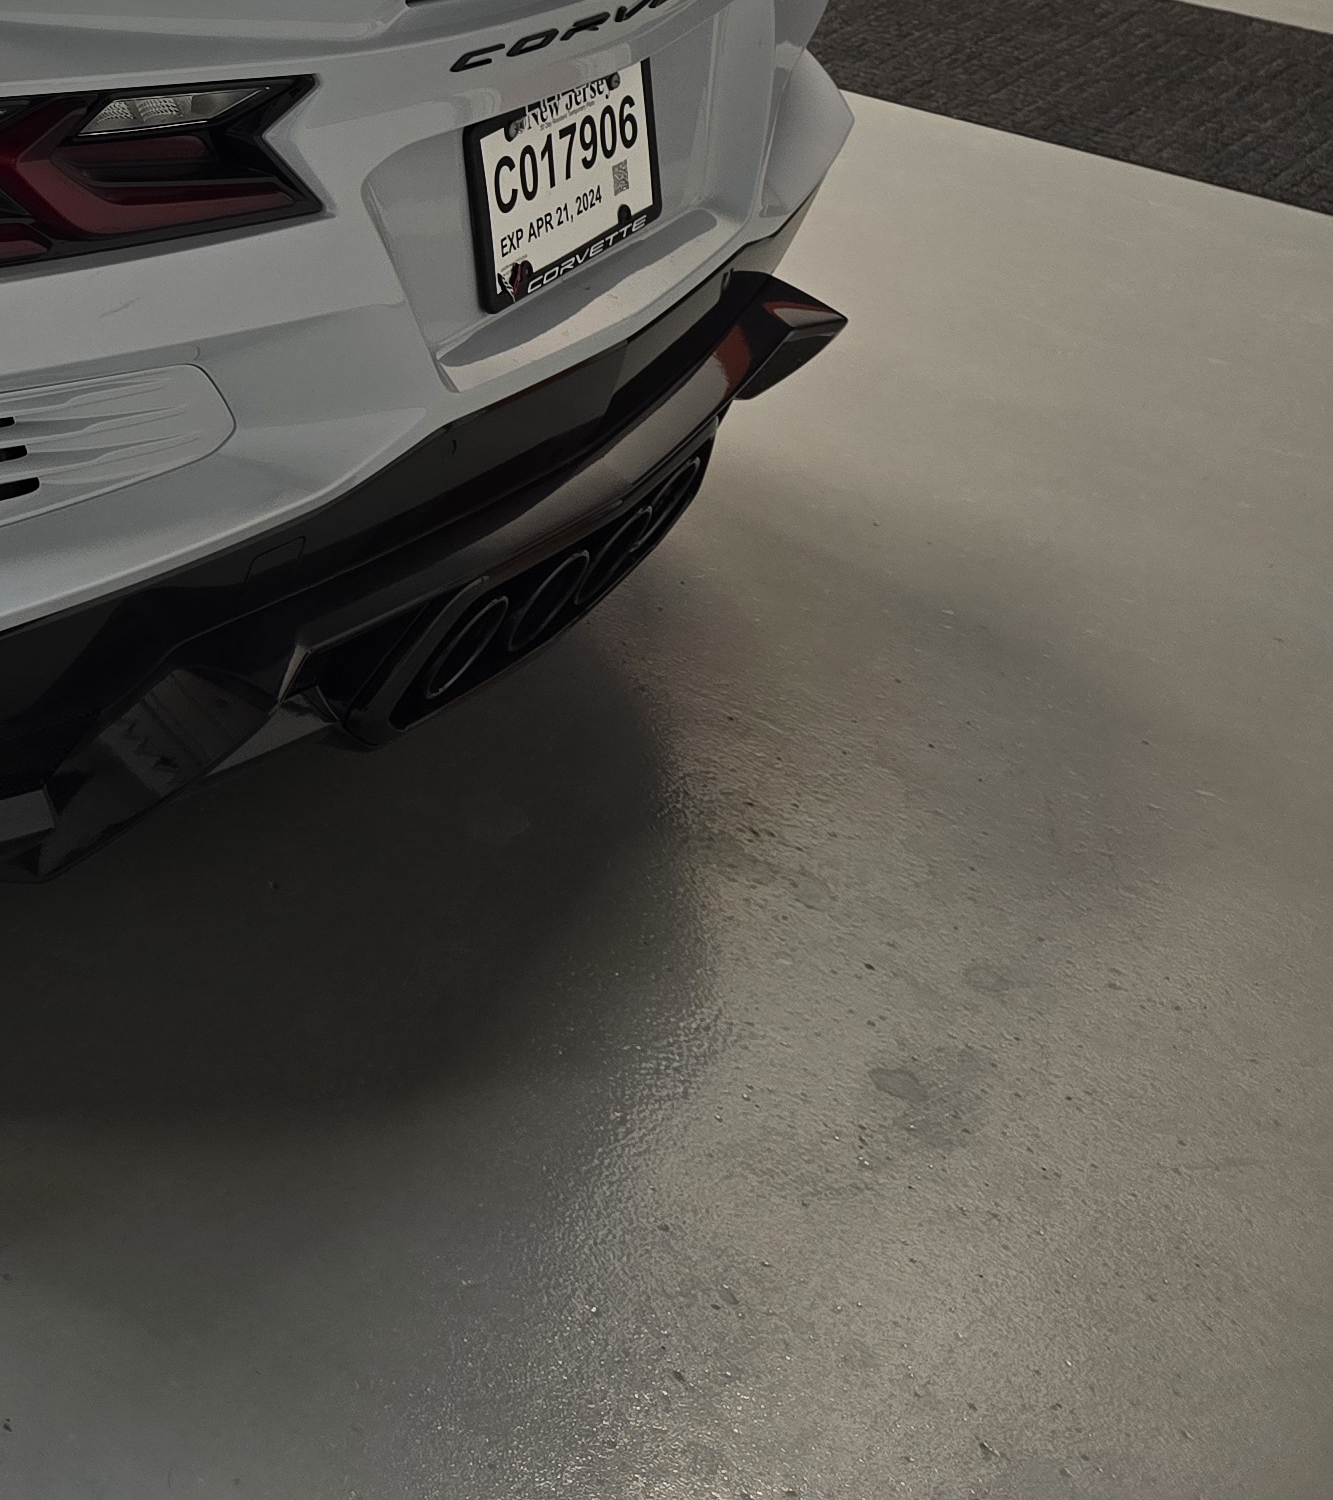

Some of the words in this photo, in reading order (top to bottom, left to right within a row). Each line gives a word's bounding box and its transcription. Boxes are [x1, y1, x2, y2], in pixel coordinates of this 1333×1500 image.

[526, 92, 562, 130] New
[494, 94, 638, 214] C017906
[500, 228, 524, 258] EXP
[527, 212, 555, 243] APR
[555, 202, 574, 227] 21,
[575, 184, 603, 216] 2024
[527, 214, 647, 294] CORVETTE
